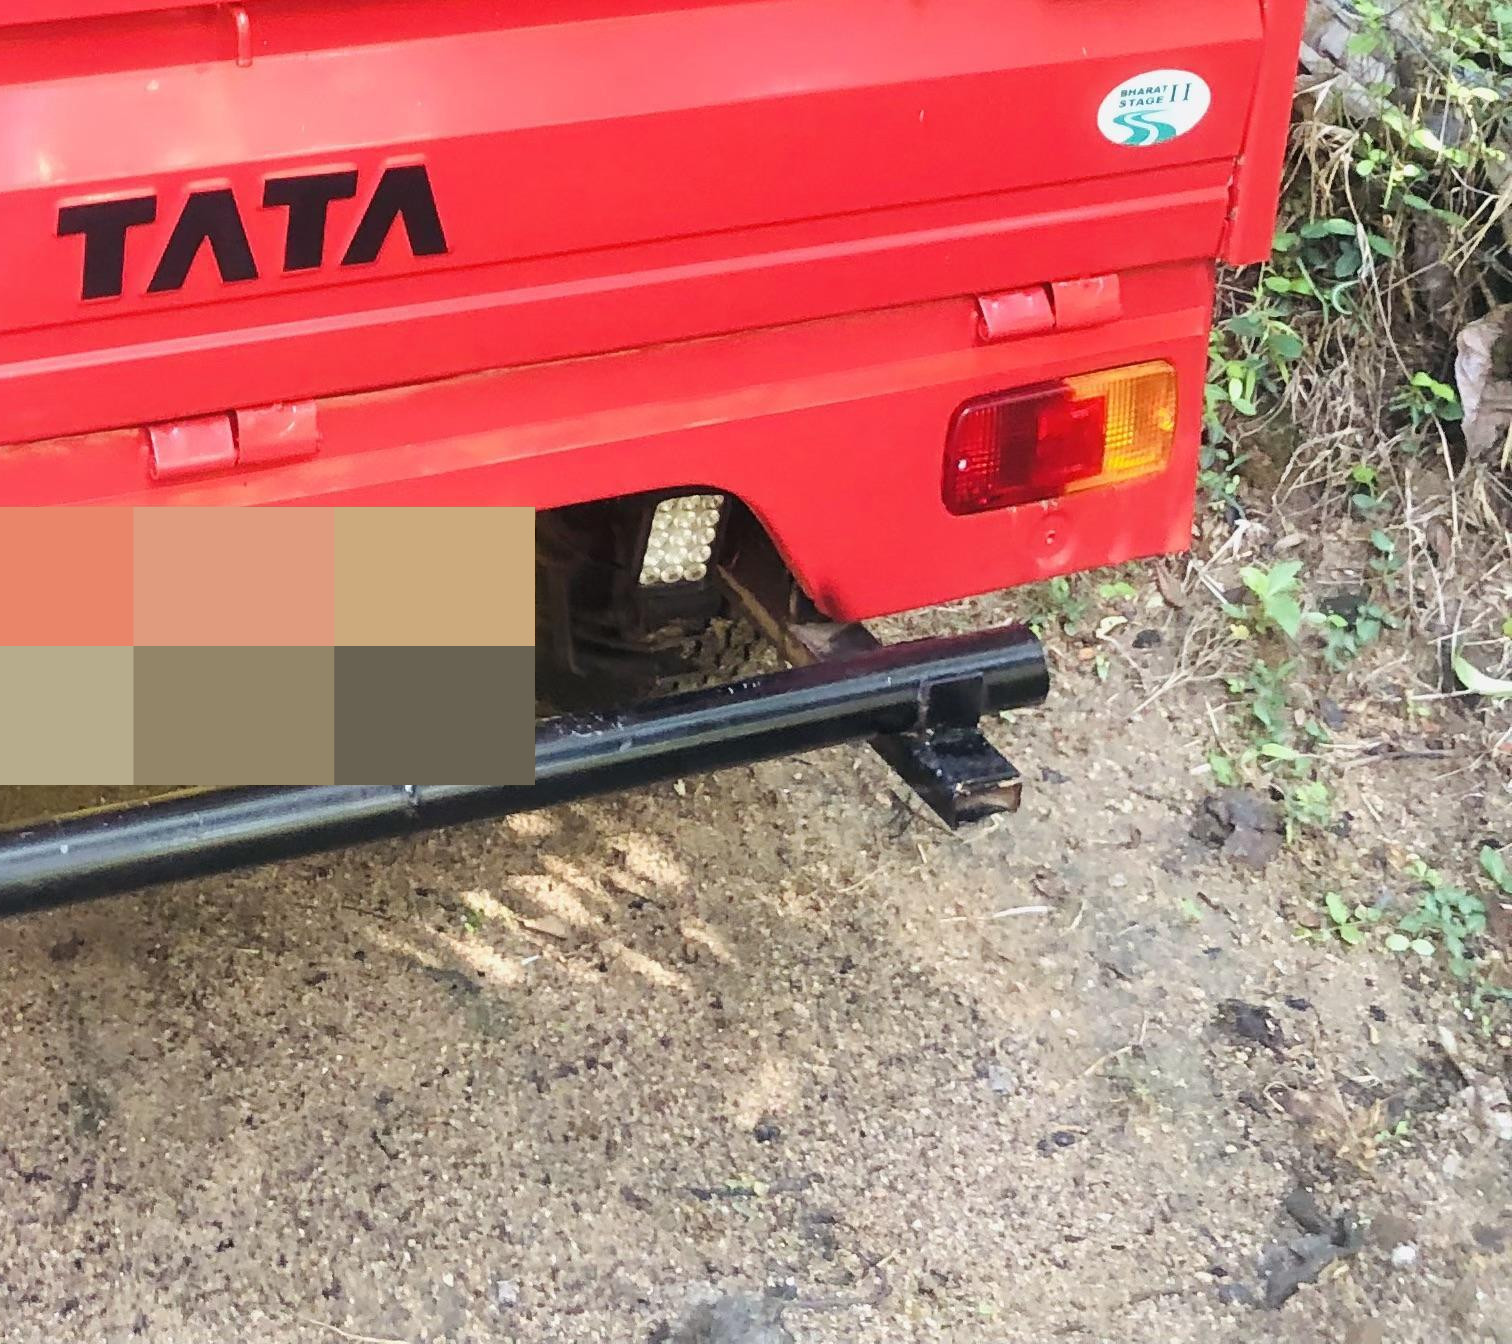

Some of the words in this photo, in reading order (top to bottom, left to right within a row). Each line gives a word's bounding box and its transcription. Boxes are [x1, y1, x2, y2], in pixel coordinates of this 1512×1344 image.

[1120, 85, 1168, 98] BHARAT
[1118, 96, 1165, 108] STAGE
[56, 163, 450, 301] TATA
